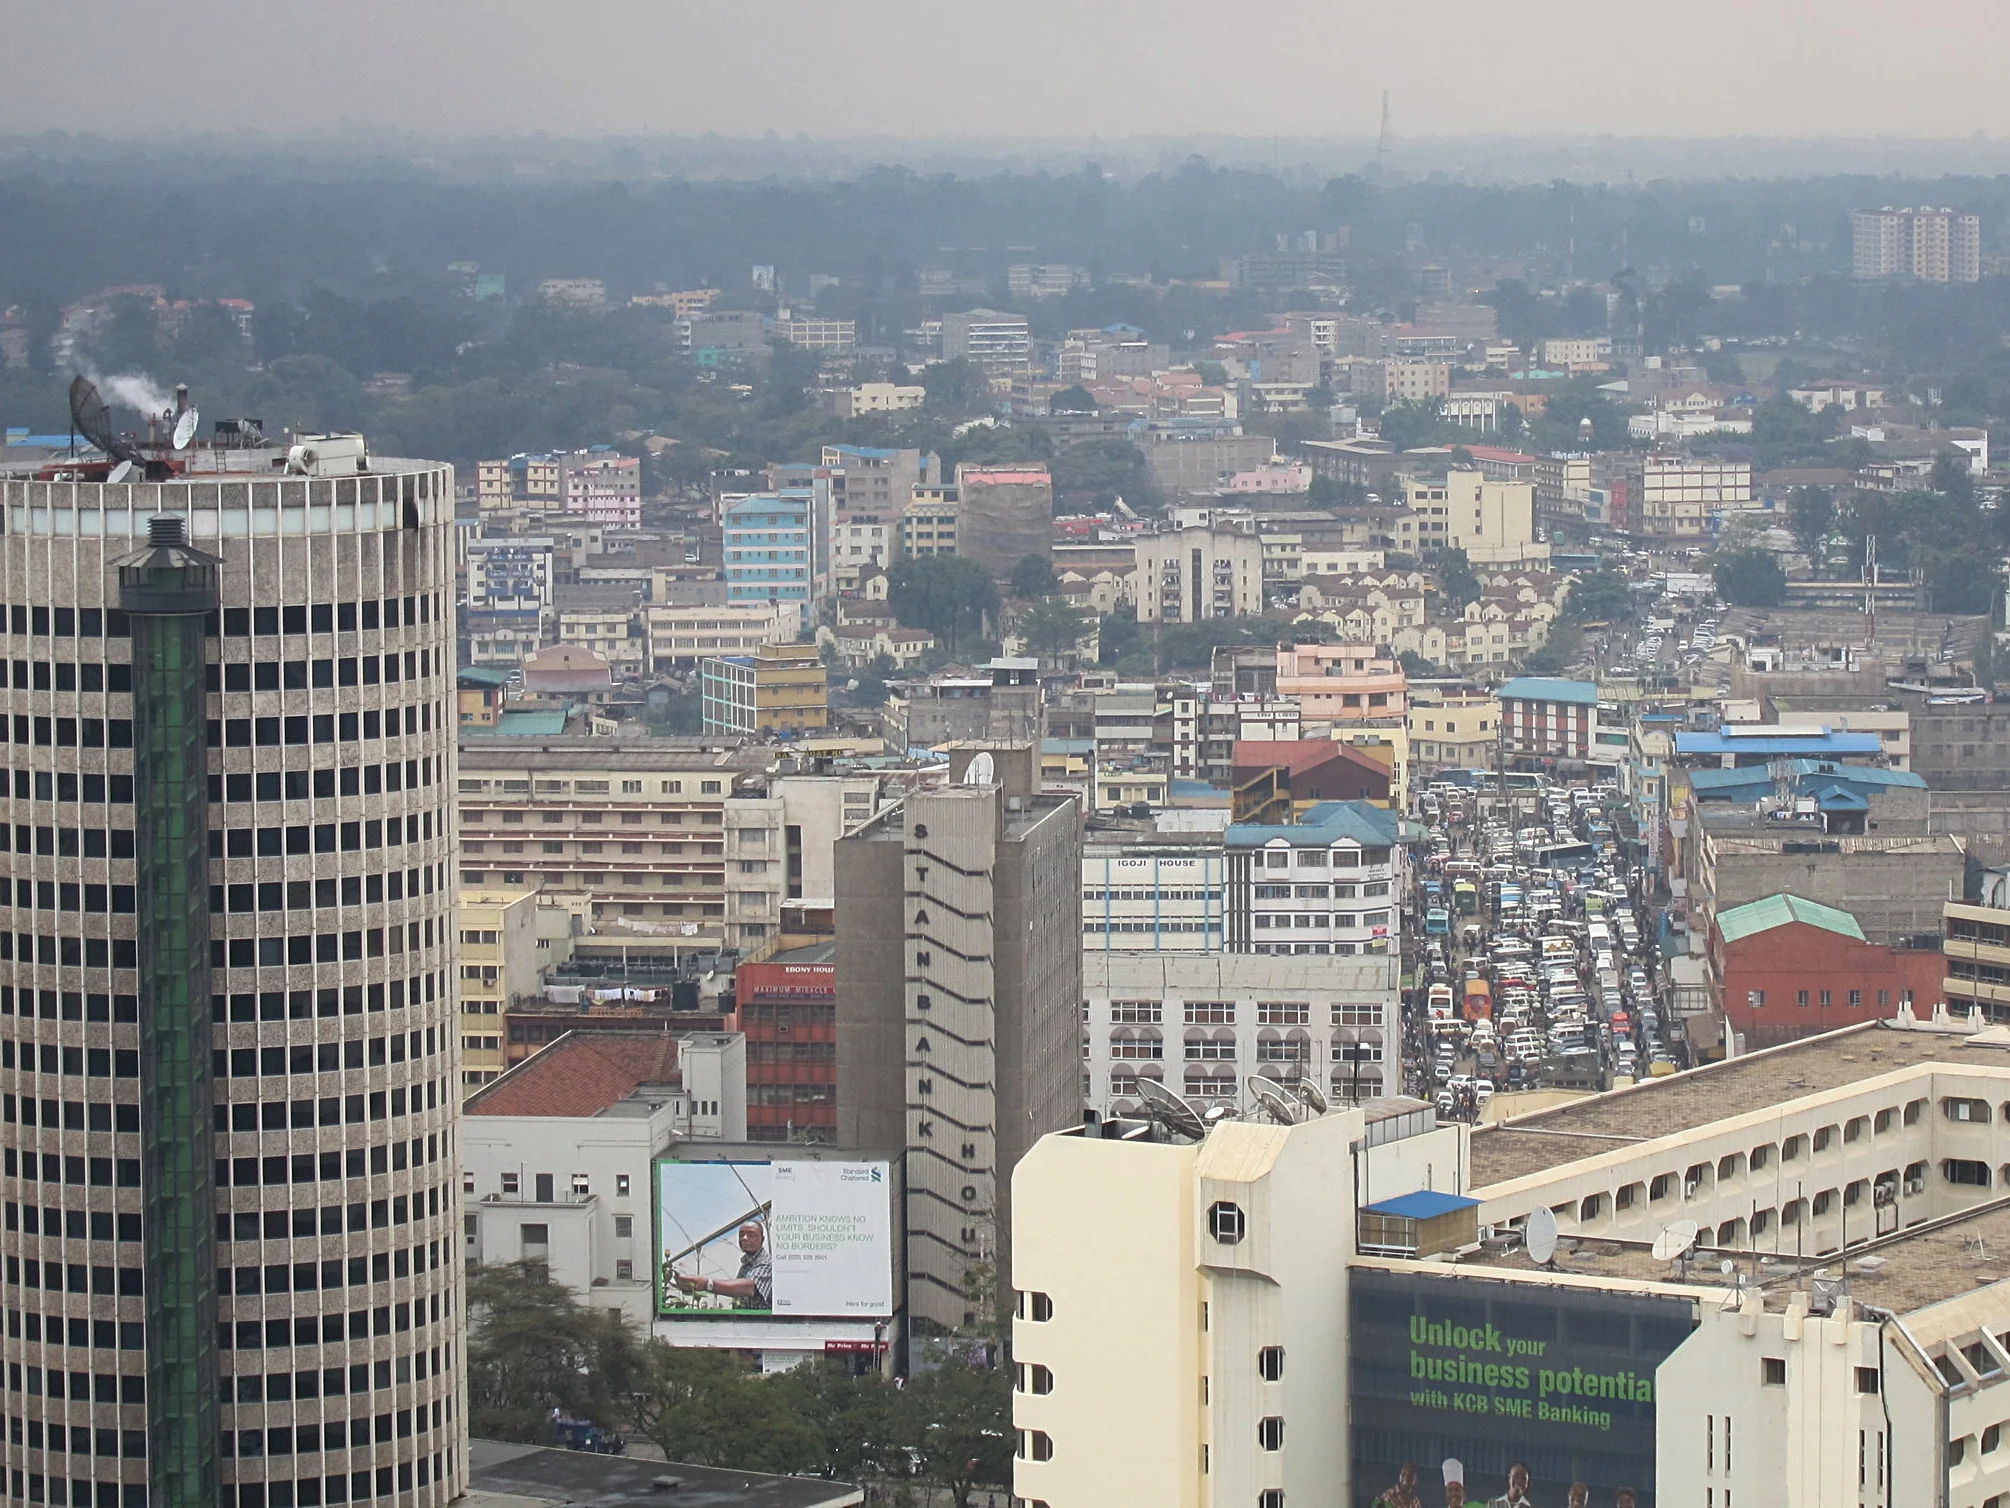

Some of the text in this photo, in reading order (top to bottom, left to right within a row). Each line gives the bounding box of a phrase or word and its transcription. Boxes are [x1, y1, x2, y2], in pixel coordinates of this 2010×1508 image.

[1117, 859, 1196, 867] IGOJI HOUSE
[795, 986, 827, 994] MIRACLE
[775, 1214, 866, 1223] AMBITION KNOWS NO
[776, 1224, 857, 1232] LIMITS. SHOULDN'T
[776, 1233, 874, 1242] YOUR BUSINESS KNOW
[776, 1242, 789, 1250] NO
[1409, 1315, 1547, 1357] Unlock your
[1410, 1350, 1530, 1389] business
[1410, 1389, 1612, 1432] with KCB SME Banking
